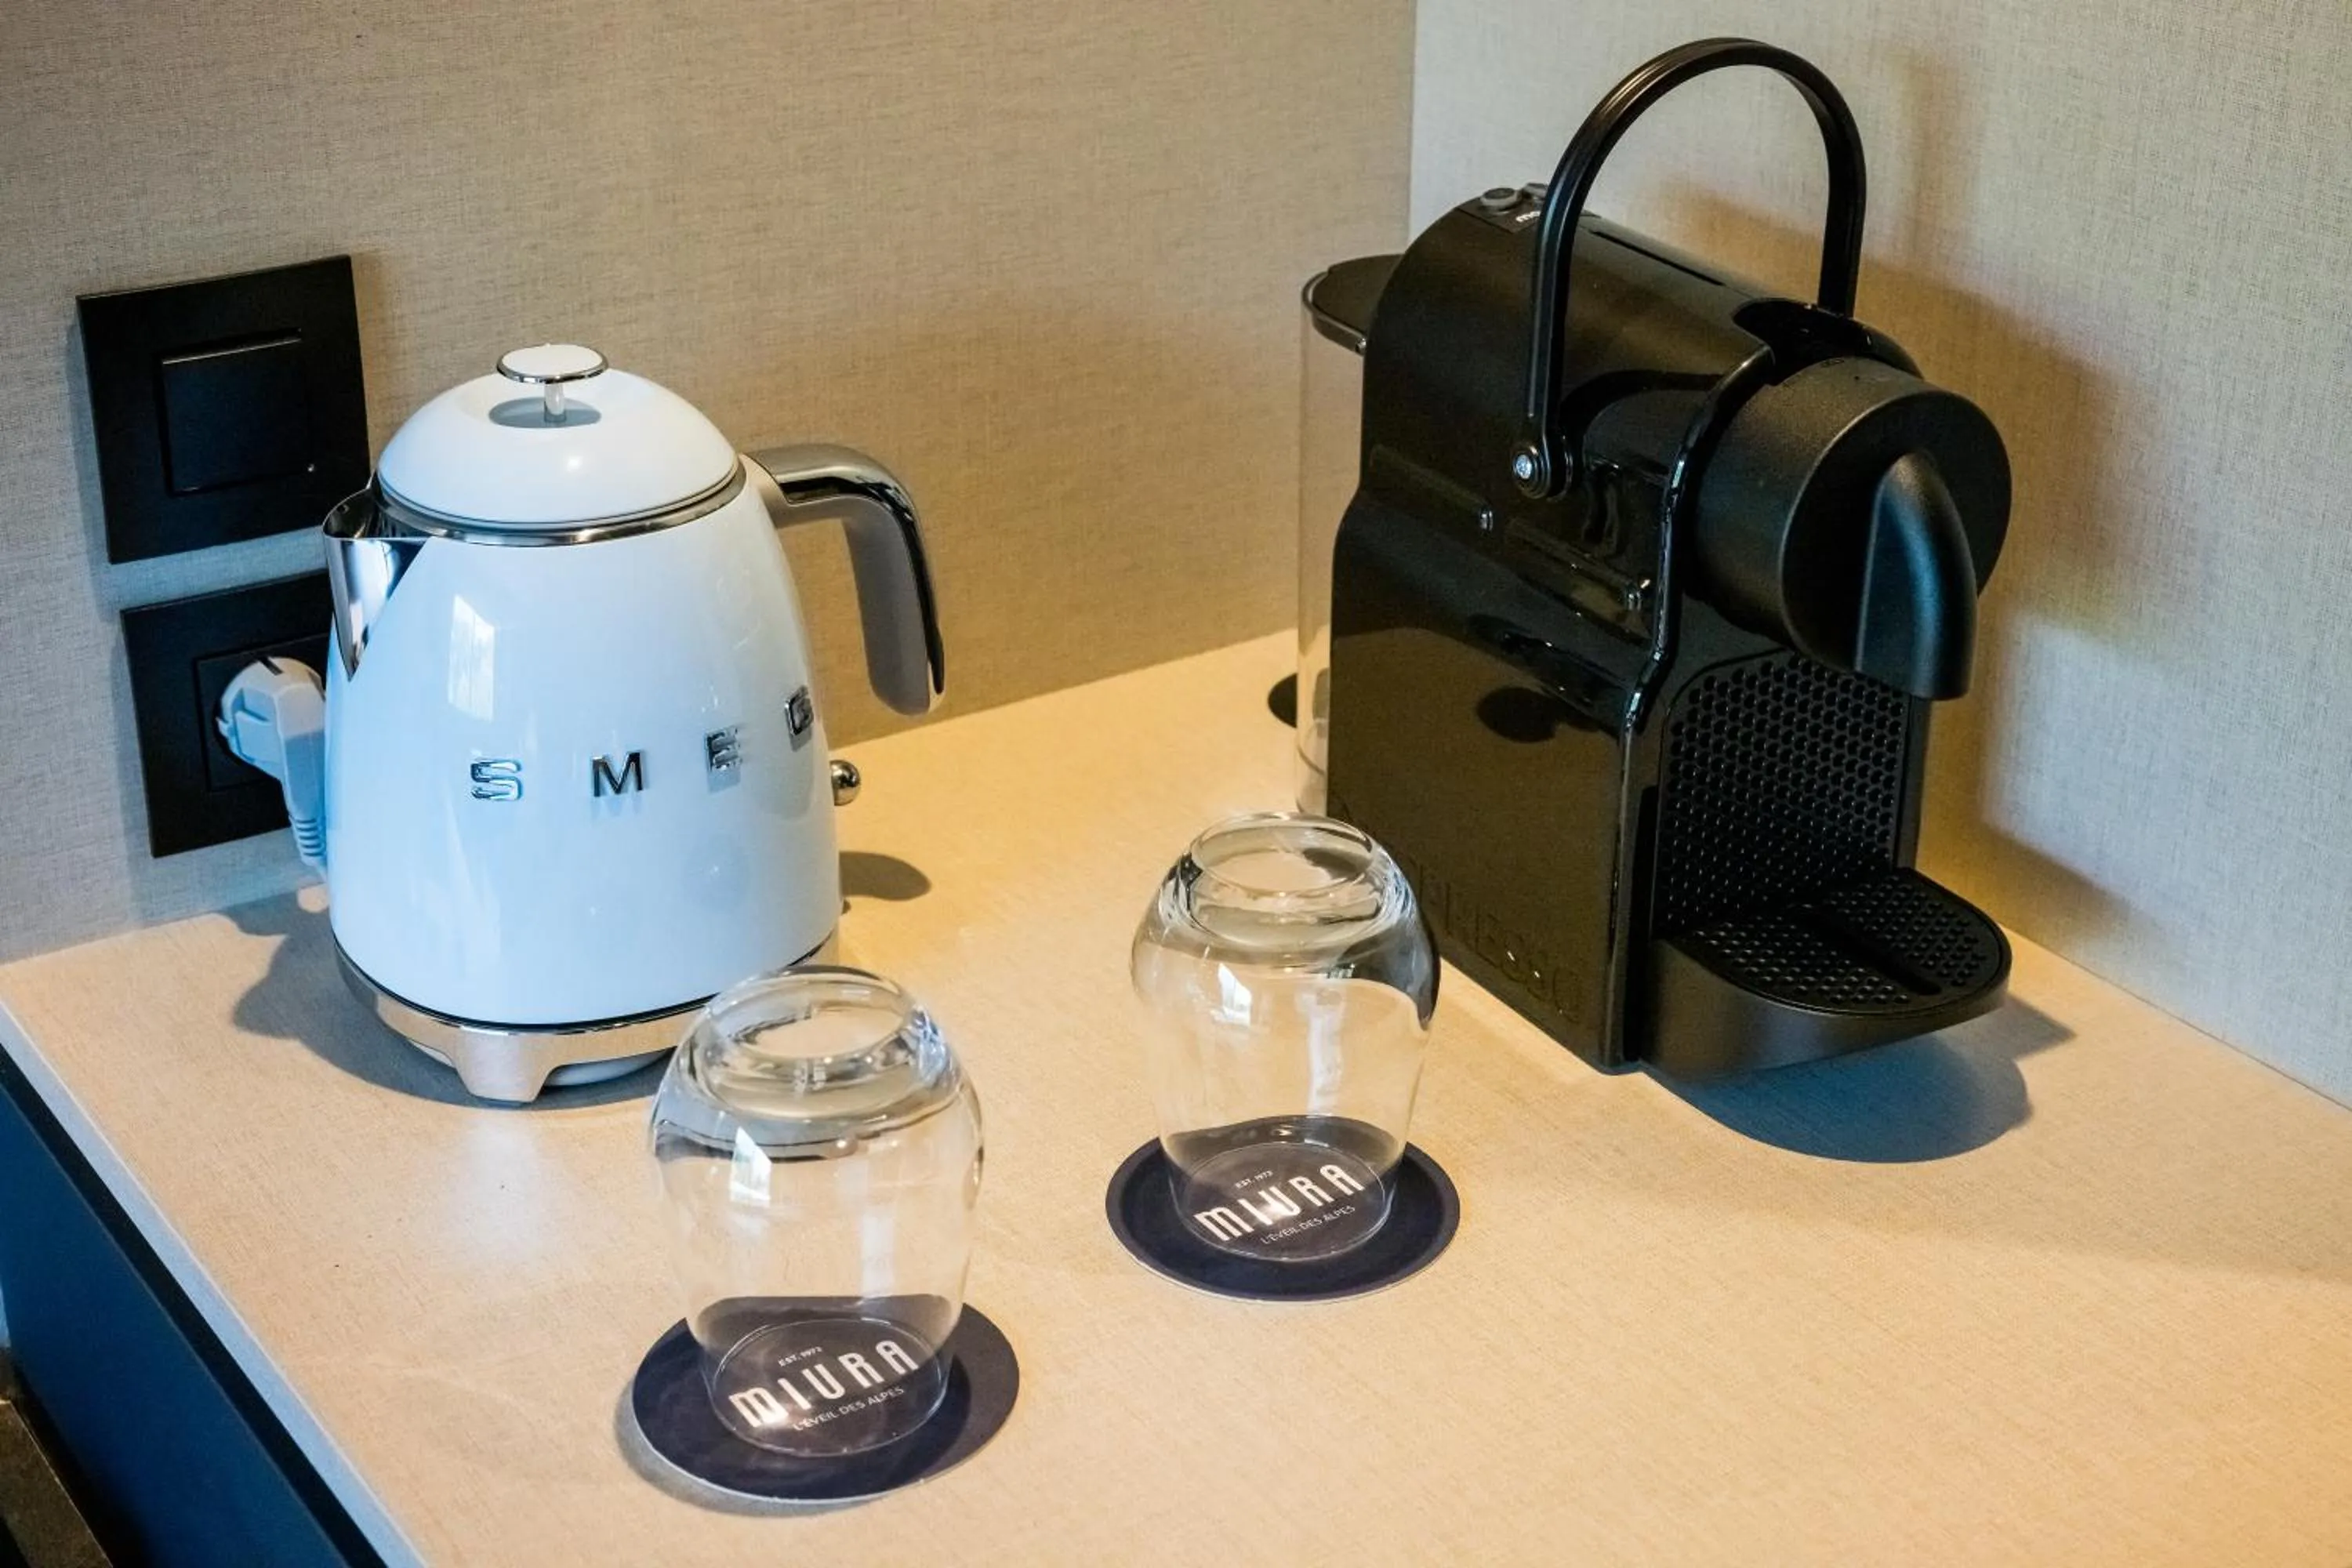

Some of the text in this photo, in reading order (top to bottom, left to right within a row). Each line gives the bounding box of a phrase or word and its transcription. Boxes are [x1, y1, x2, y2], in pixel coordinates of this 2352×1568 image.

[470, 684, 814, 801] SMEG
[1193, 1164, 1365, 1241] MIURA
[1298, 1217, 1323, 1231] DES
[1323, 1205, 1356, 1222] ALPES
[728, 1340, 919, 1428] MIURA
[839, 1399, 866, 1415] DES
[867, 1386, 905, 1406] ALPES
